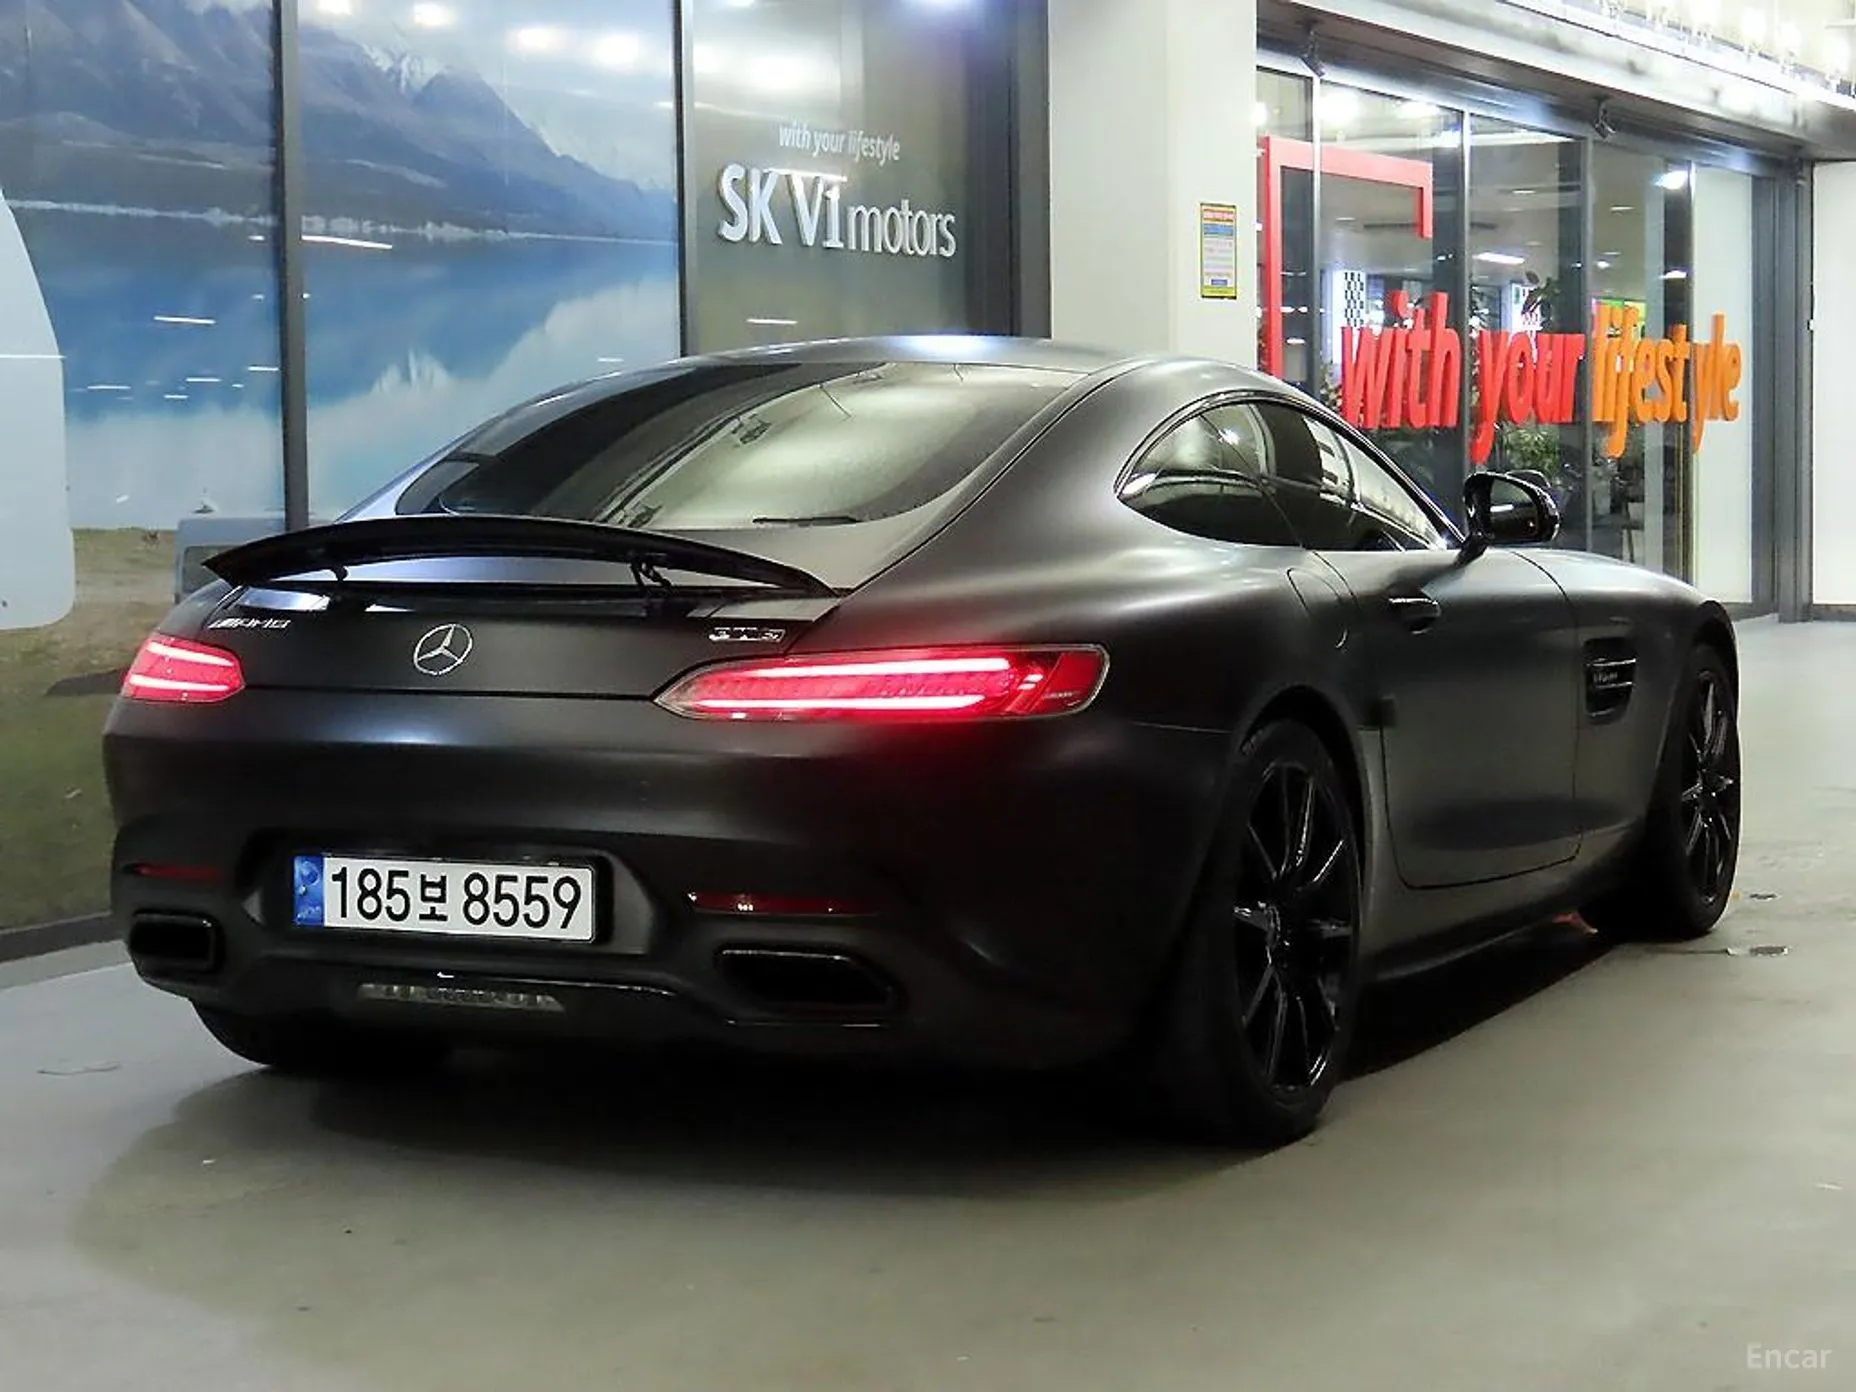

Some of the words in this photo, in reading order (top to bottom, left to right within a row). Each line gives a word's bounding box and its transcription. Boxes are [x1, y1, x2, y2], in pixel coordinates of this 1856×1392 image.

[779, 121, 811, 149] with
[812, 130, 846, 157] your
[847, 130, 900, 167] lifestyle
[718, 163, 783, 245] SK
[848, 199, 957, 258] motors
[1341, 290, 1462, 428] with
[1471, 328, 1585, 464] your
[1590, 300, 1742, 458] lifestyle
[332, 866, 448, 922] 185보
[463, 872, 582, 930] 8559
